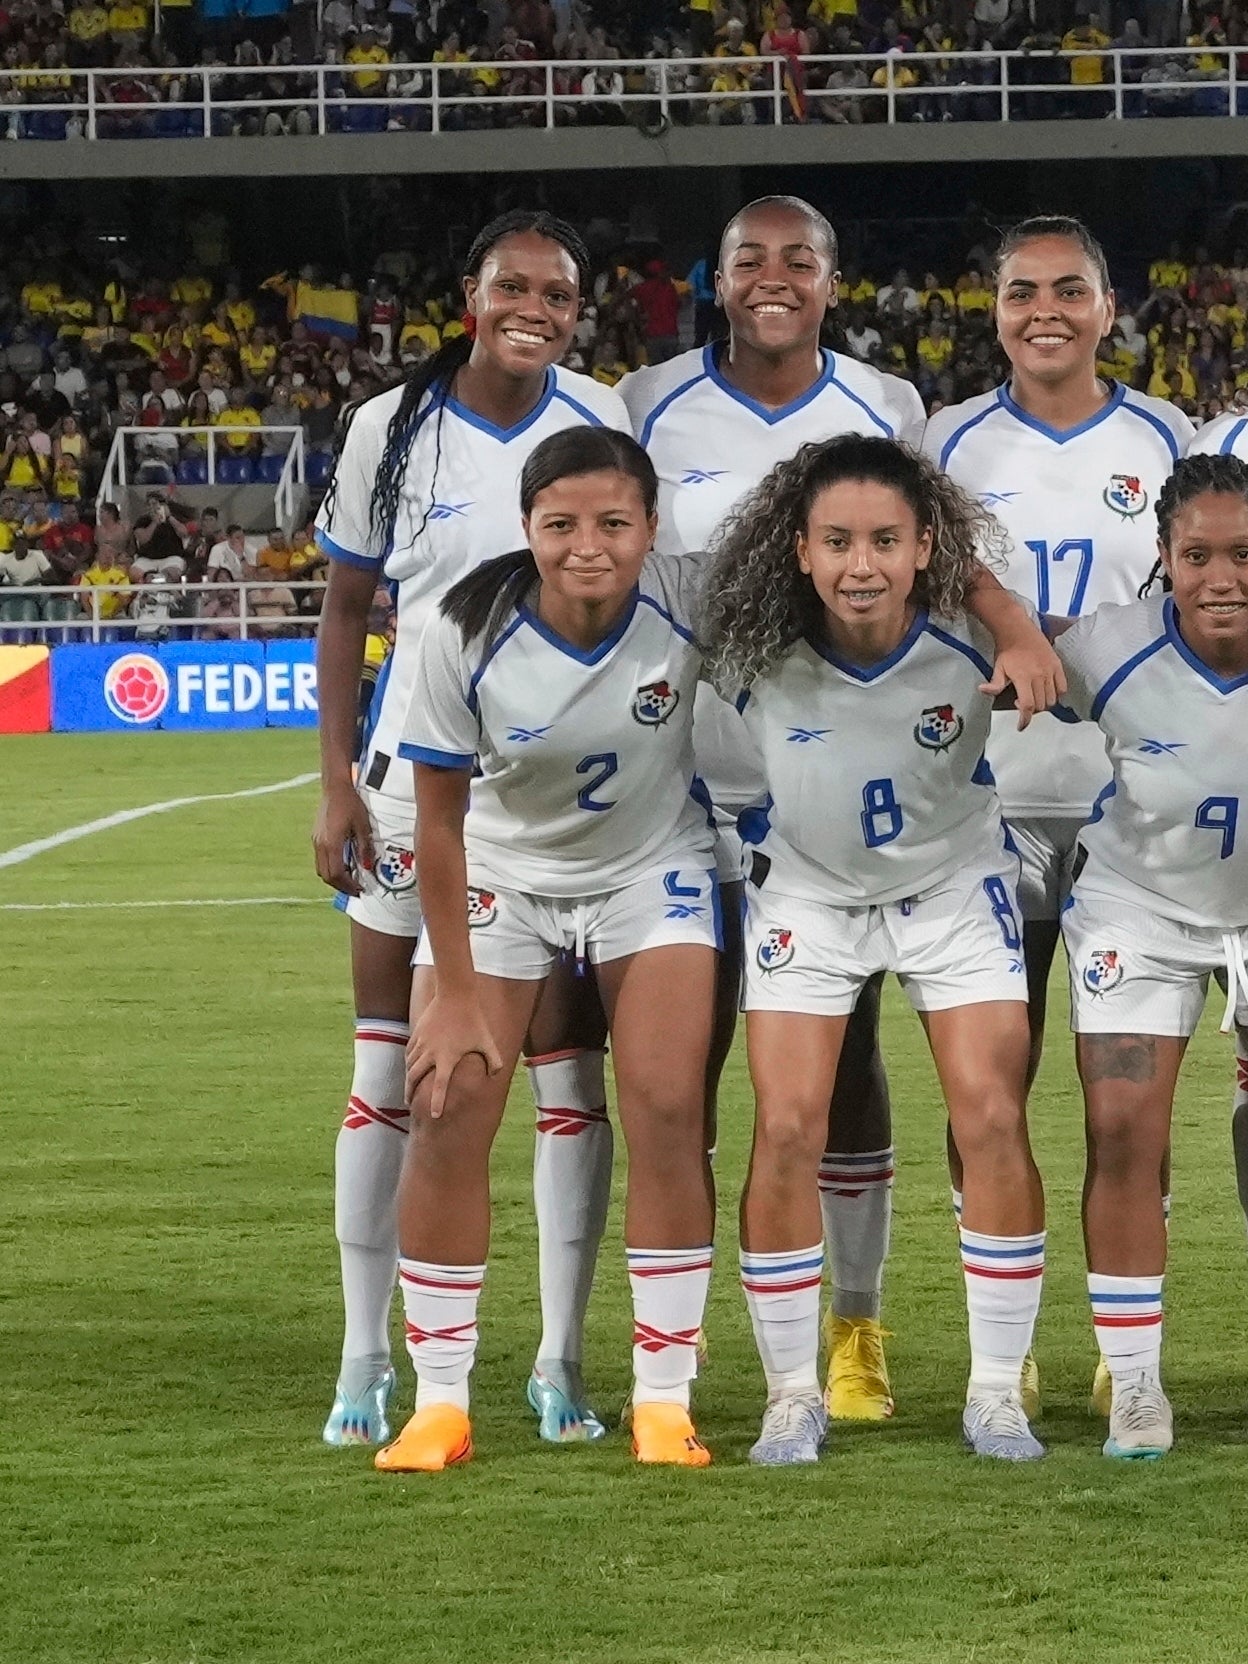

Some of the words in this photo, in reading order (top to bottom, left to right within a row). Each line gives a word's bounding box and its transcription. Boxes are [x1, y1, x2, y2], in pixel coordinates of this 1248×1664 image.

[1024, 538, 1094, 617] 17
[177, 662, 319, 713] FEDER
[576, 752, 618, 811] 2
[860, 777, 903, 848] 8
[1196, 795, 1240, 861] 9
[983, 876, 1021, 950] 8
